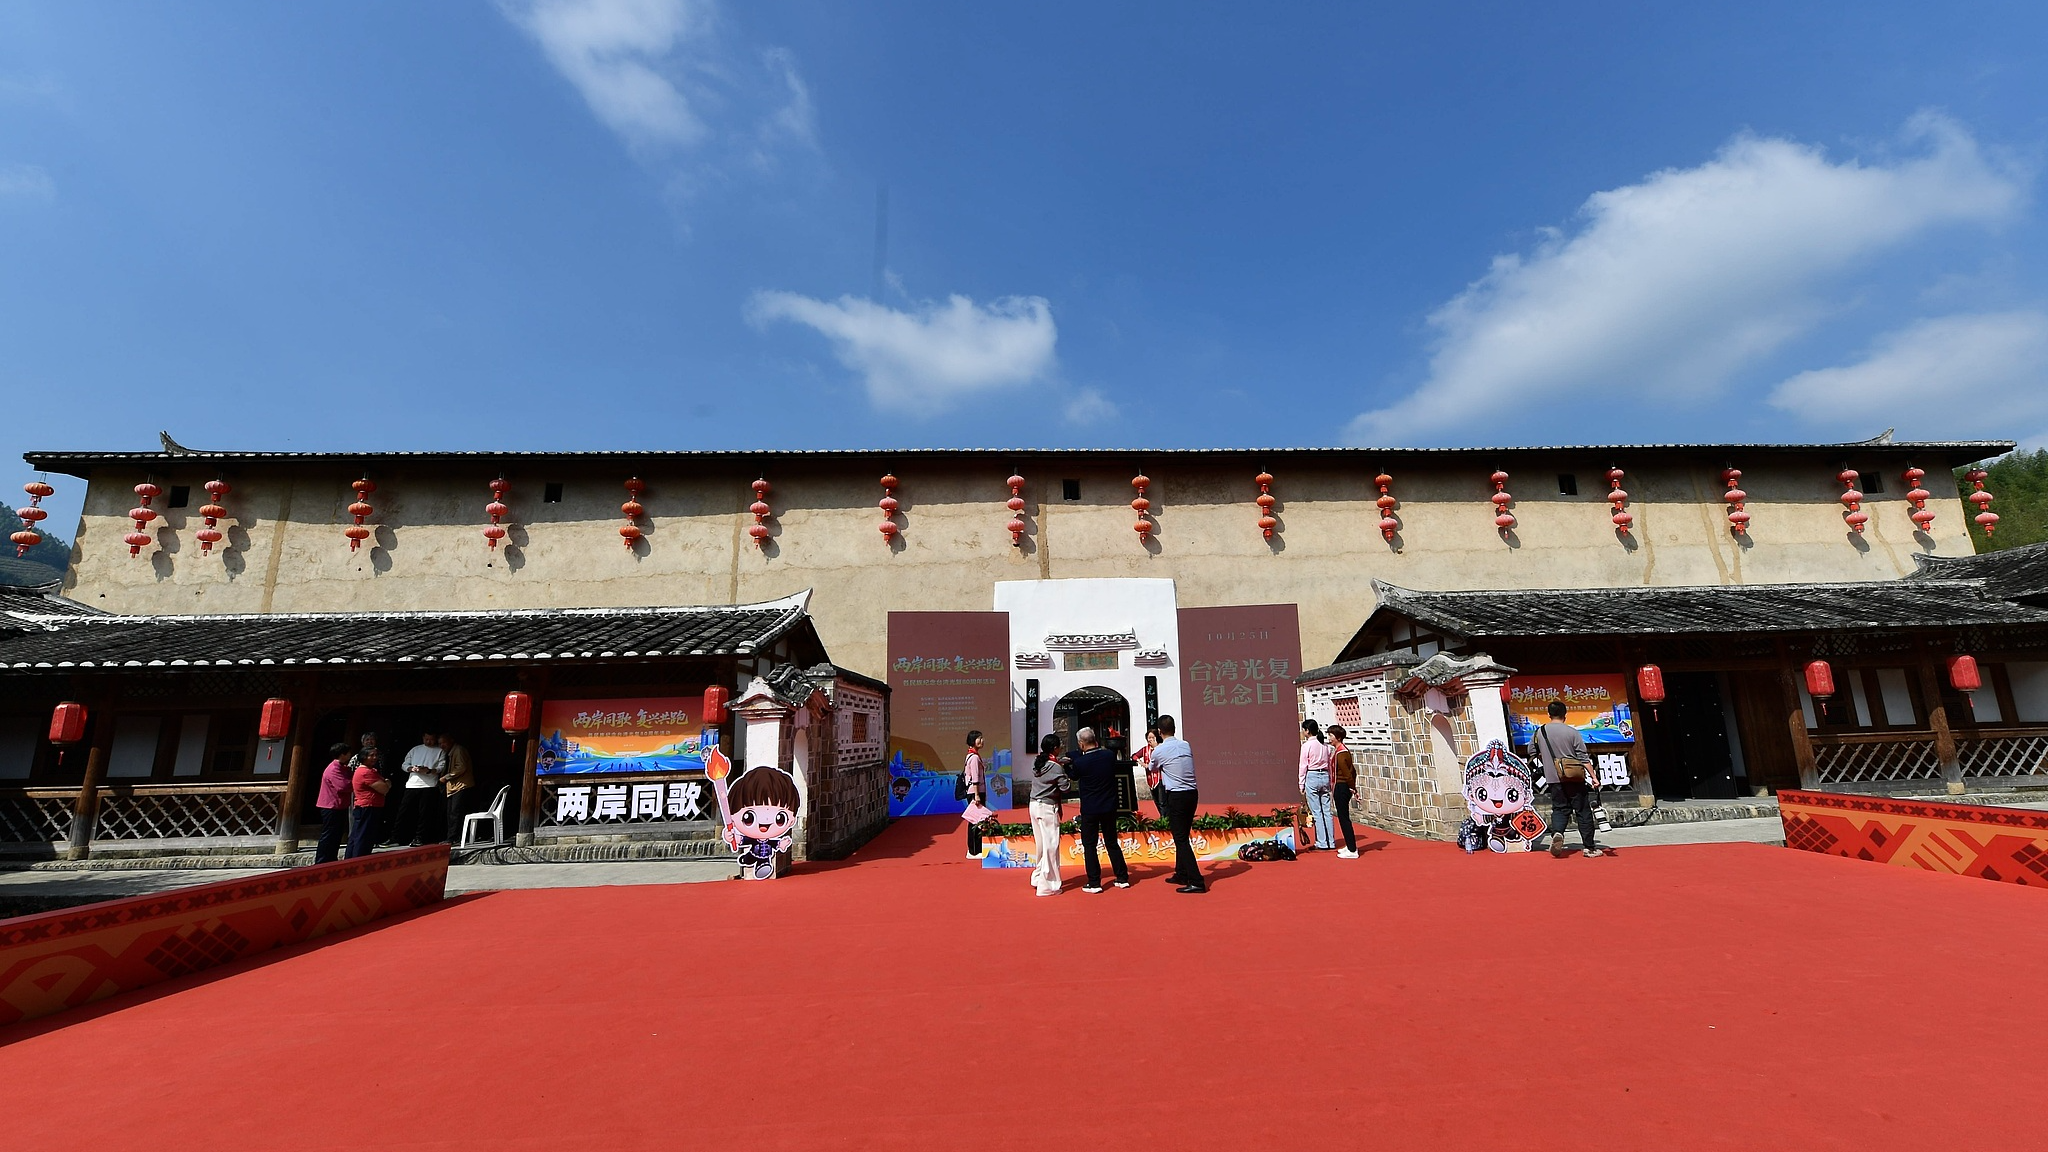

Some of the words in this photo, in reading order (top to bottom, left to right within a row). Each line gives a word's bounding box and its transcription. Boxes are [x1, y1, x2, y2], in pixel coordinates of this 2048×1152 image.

[1207, 631, 1269, 641] 10月25日
[893, 655, 952, 675] 两岸同歌
[954, 655, 1005, 674] 复兴共跑
[1189, 658, 1292, 682] 台湾光复
[1203, 682, 1279, 706] 纪念日
[1510, 685, 1561, 704] 两岸同歌
[1563, 684, 1611, 703] 复兴共跑
[572, 709, 632, 730] 两岸同歌
[636, 708, 689, 729] 复兴共跑
[557, 782, 702, 821] 两岸同歌
[1520, 815, 1537, 832] 福
[1069, 836, 1142, 860] 两岸歌
[1147, 834, 1211, 860] 复兴跑
